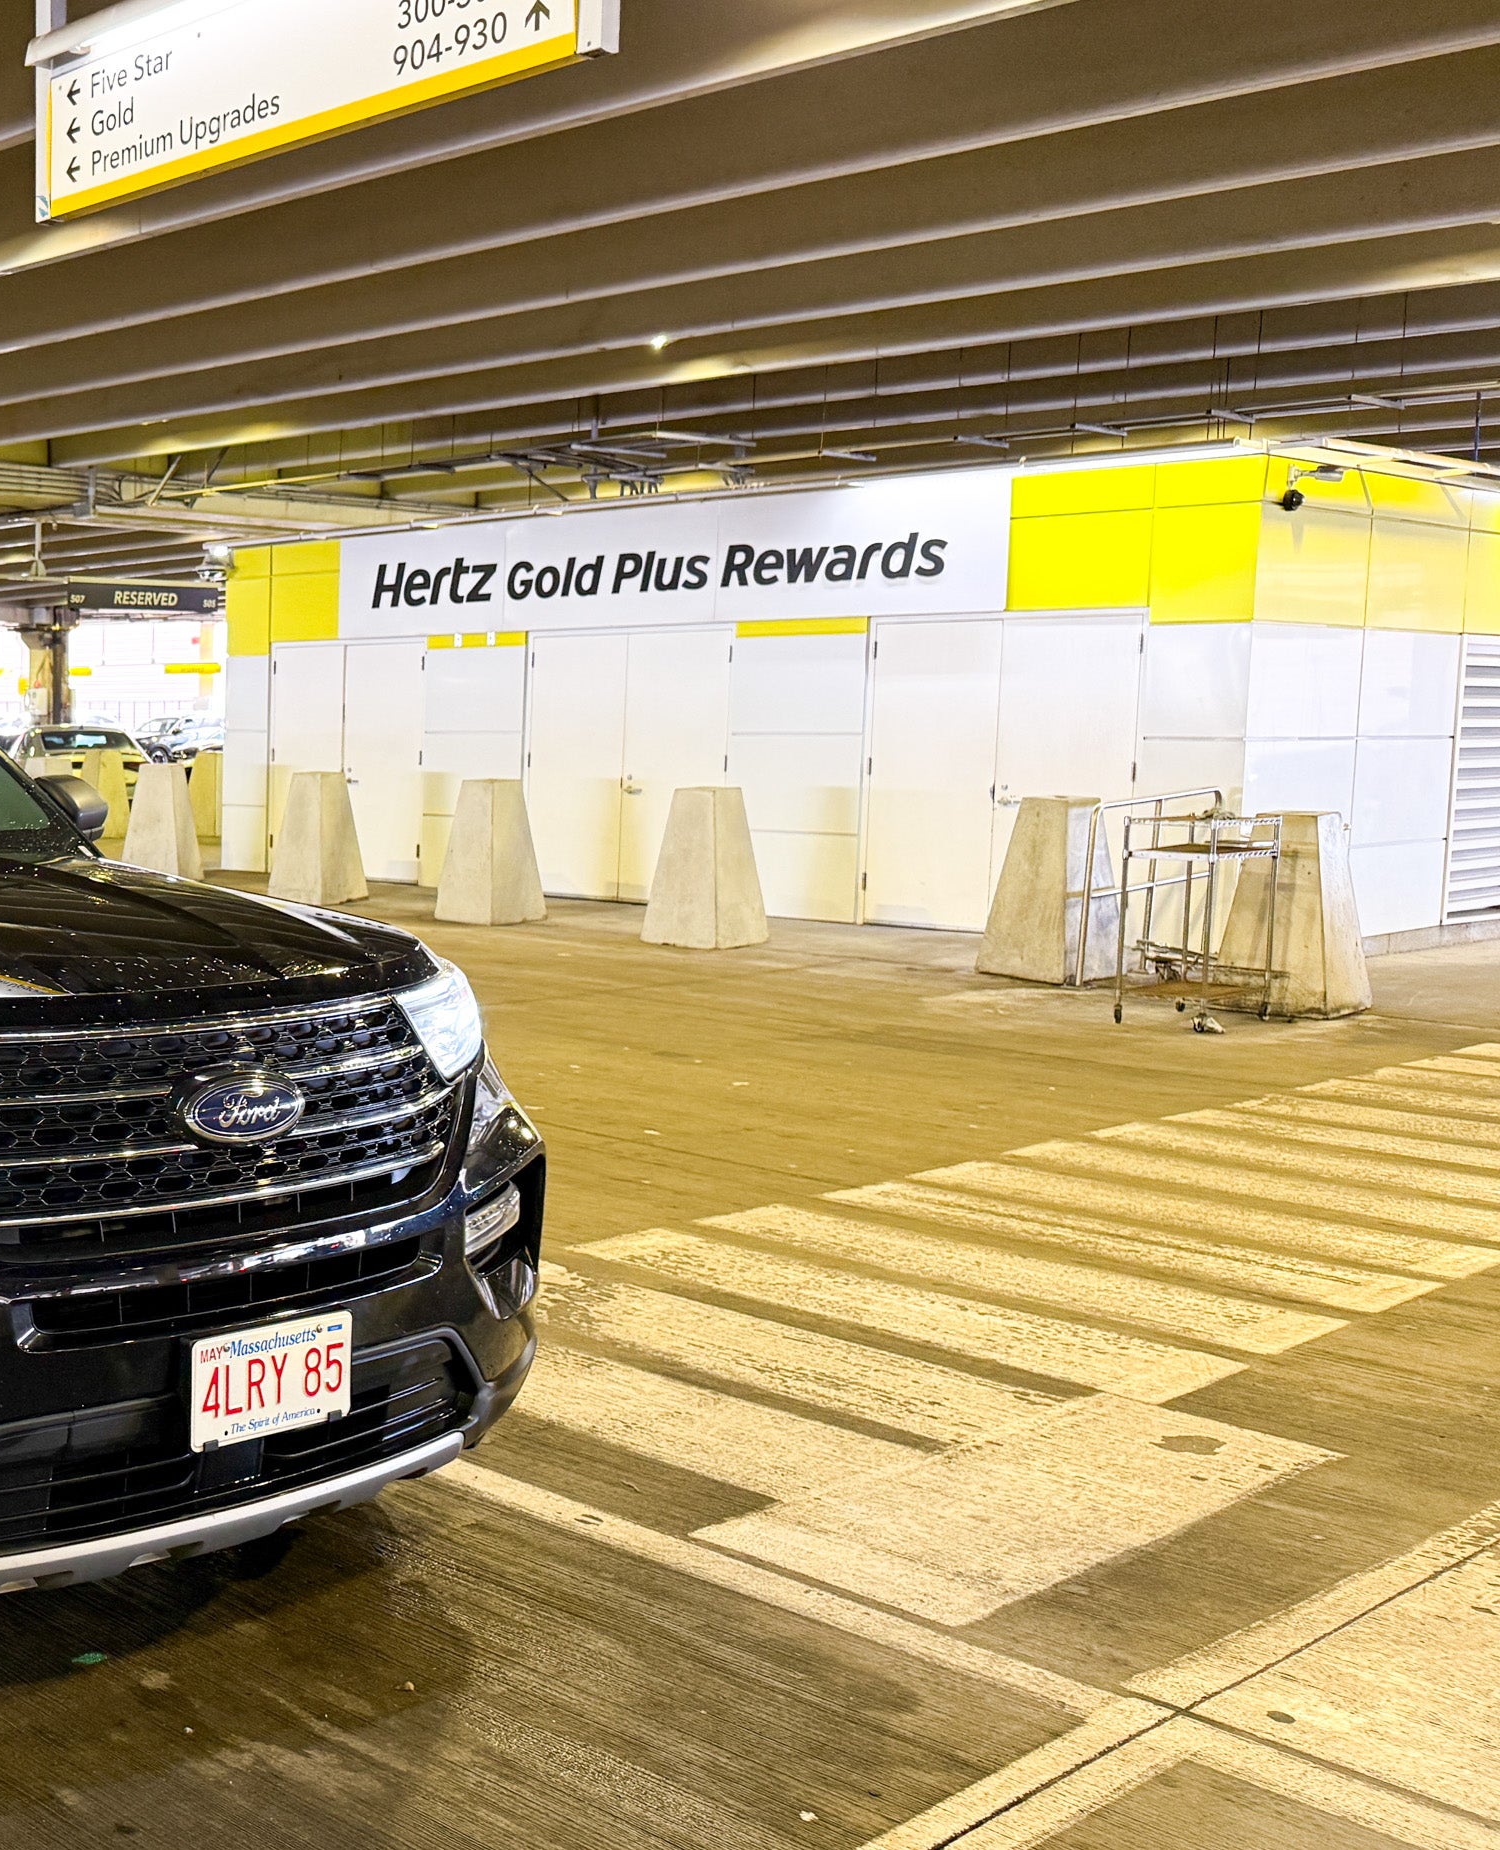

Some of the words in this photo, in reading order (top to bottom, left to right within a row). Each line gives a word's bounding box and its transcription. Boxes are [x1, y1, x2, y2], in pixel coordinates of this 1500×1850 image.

[393, 11, 507, 76] 904-930
[90, 68, 128, 99] Five
[134, 50, 173, 82] Star
[91, 96, 134, 137] Gold
[91, 131, 173, 177] Premium
[179, 92, 280, 150] Upgrades
[371, 556, 497, 609] Hertz
[507, 554, 605, 600] Gold
[611, 548, 710, 595] Plus
[720, 531, 948, 589] Rewards
[114, 591, 178, 606] RESERVED
[219, 1091, 281, 1128] Ford
[200, 1346, 224, 1364] MAY
[229, 1328, 317, 1359] Massachusetts
[202, 1353, 288, 1419] 4LRY
[304, 1342, 344, 1398] 85
[230, 1421, 246, 1435] The
[248, 1415, 270, 1431] Spirit
[272, 1411, 280, 1425] of
[282, 1407, 315, 1421] America
